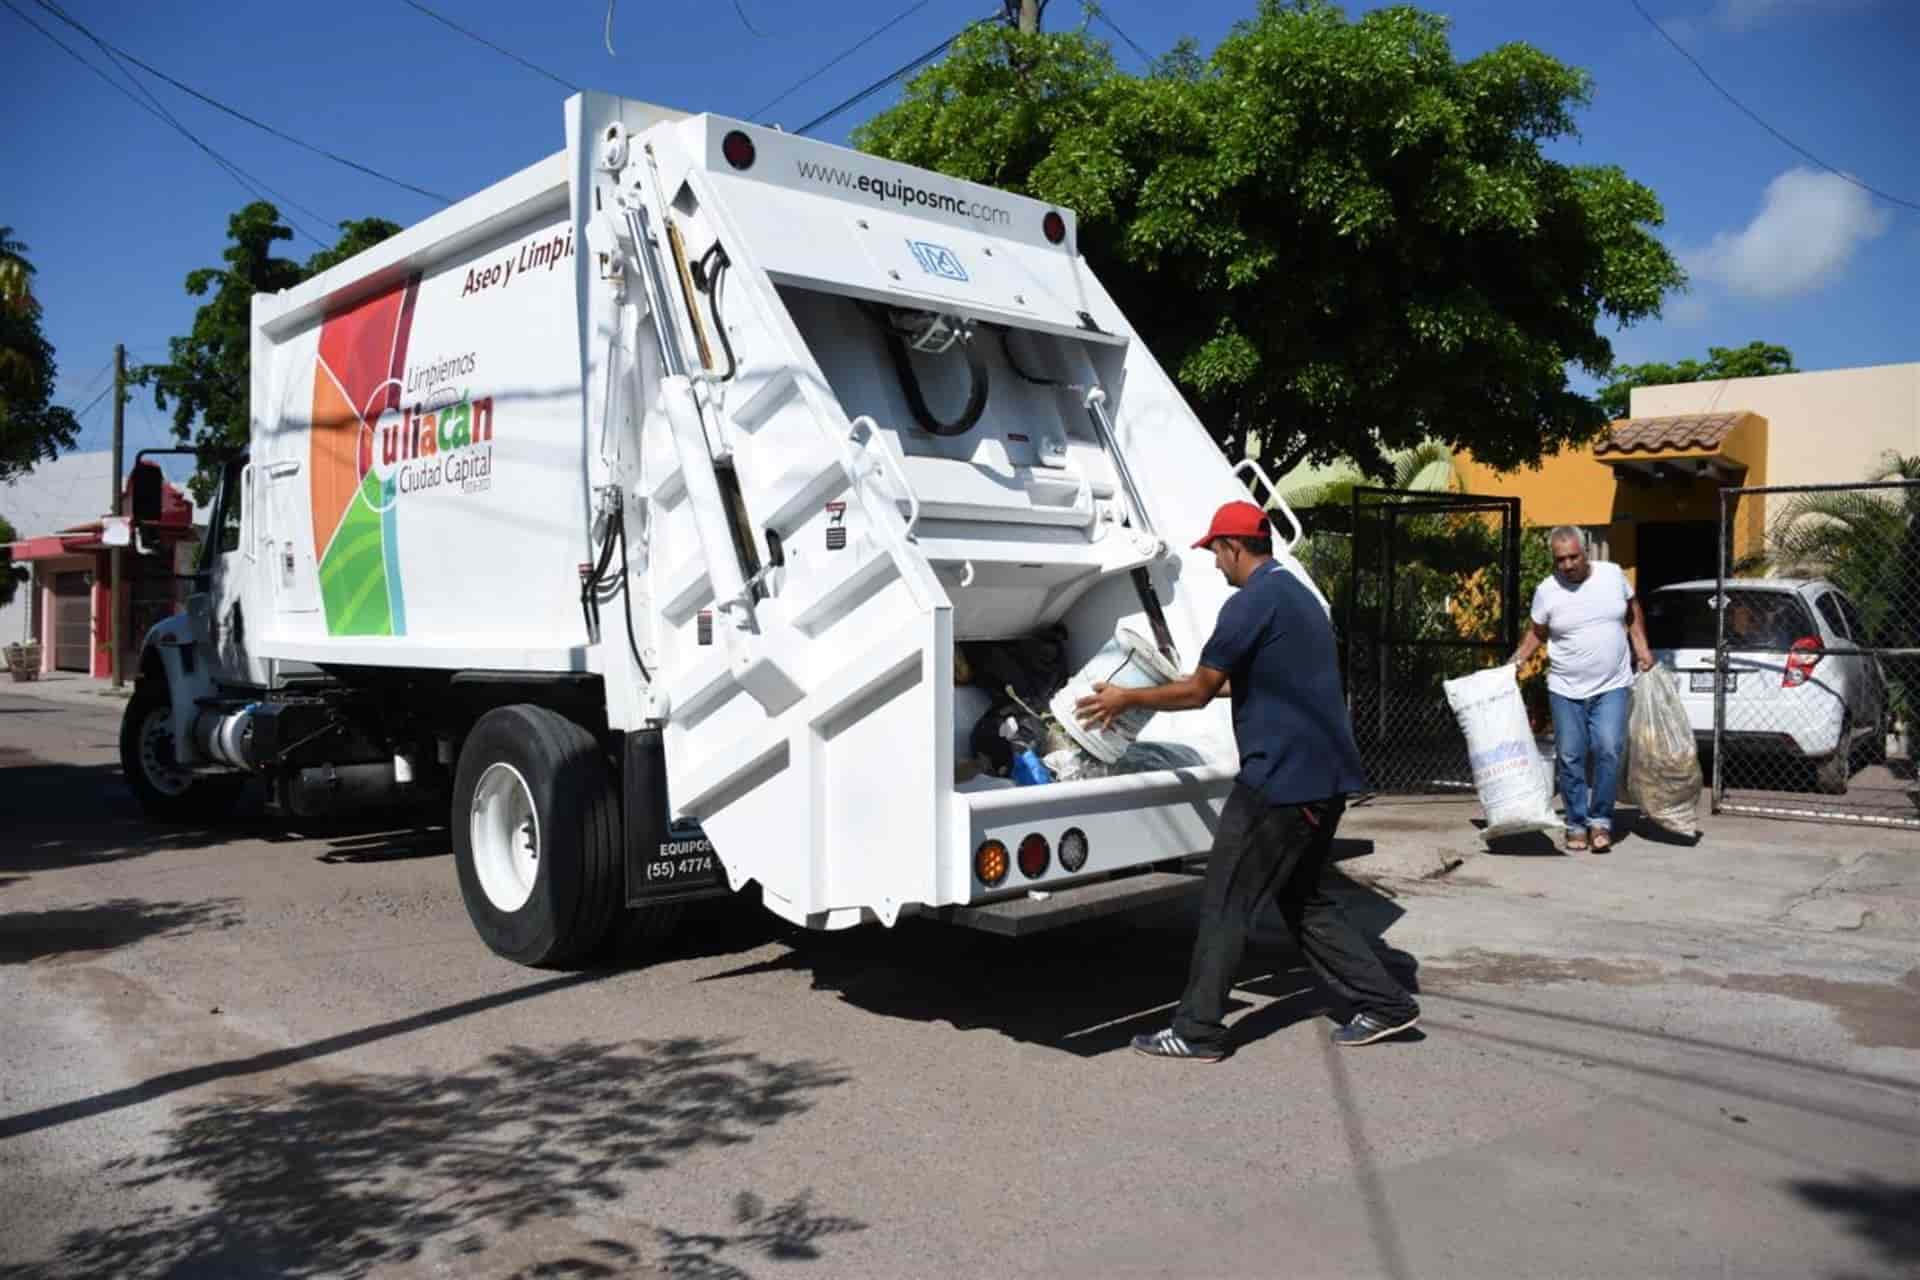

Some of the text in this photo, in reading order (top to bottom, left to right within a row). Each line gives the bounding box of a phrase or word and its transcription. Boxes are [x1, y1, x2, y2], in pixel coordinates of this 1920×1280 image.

[797, 160, 1011, 225] www.equiposmc.com
[462, 226, 575, 298] Aseo y Limpi
[407, 351, 476, 393] Limpiemos
[400, 445, 492, 493] Ciudad Capital
[647, 857, 712, 880] (55) 4774
